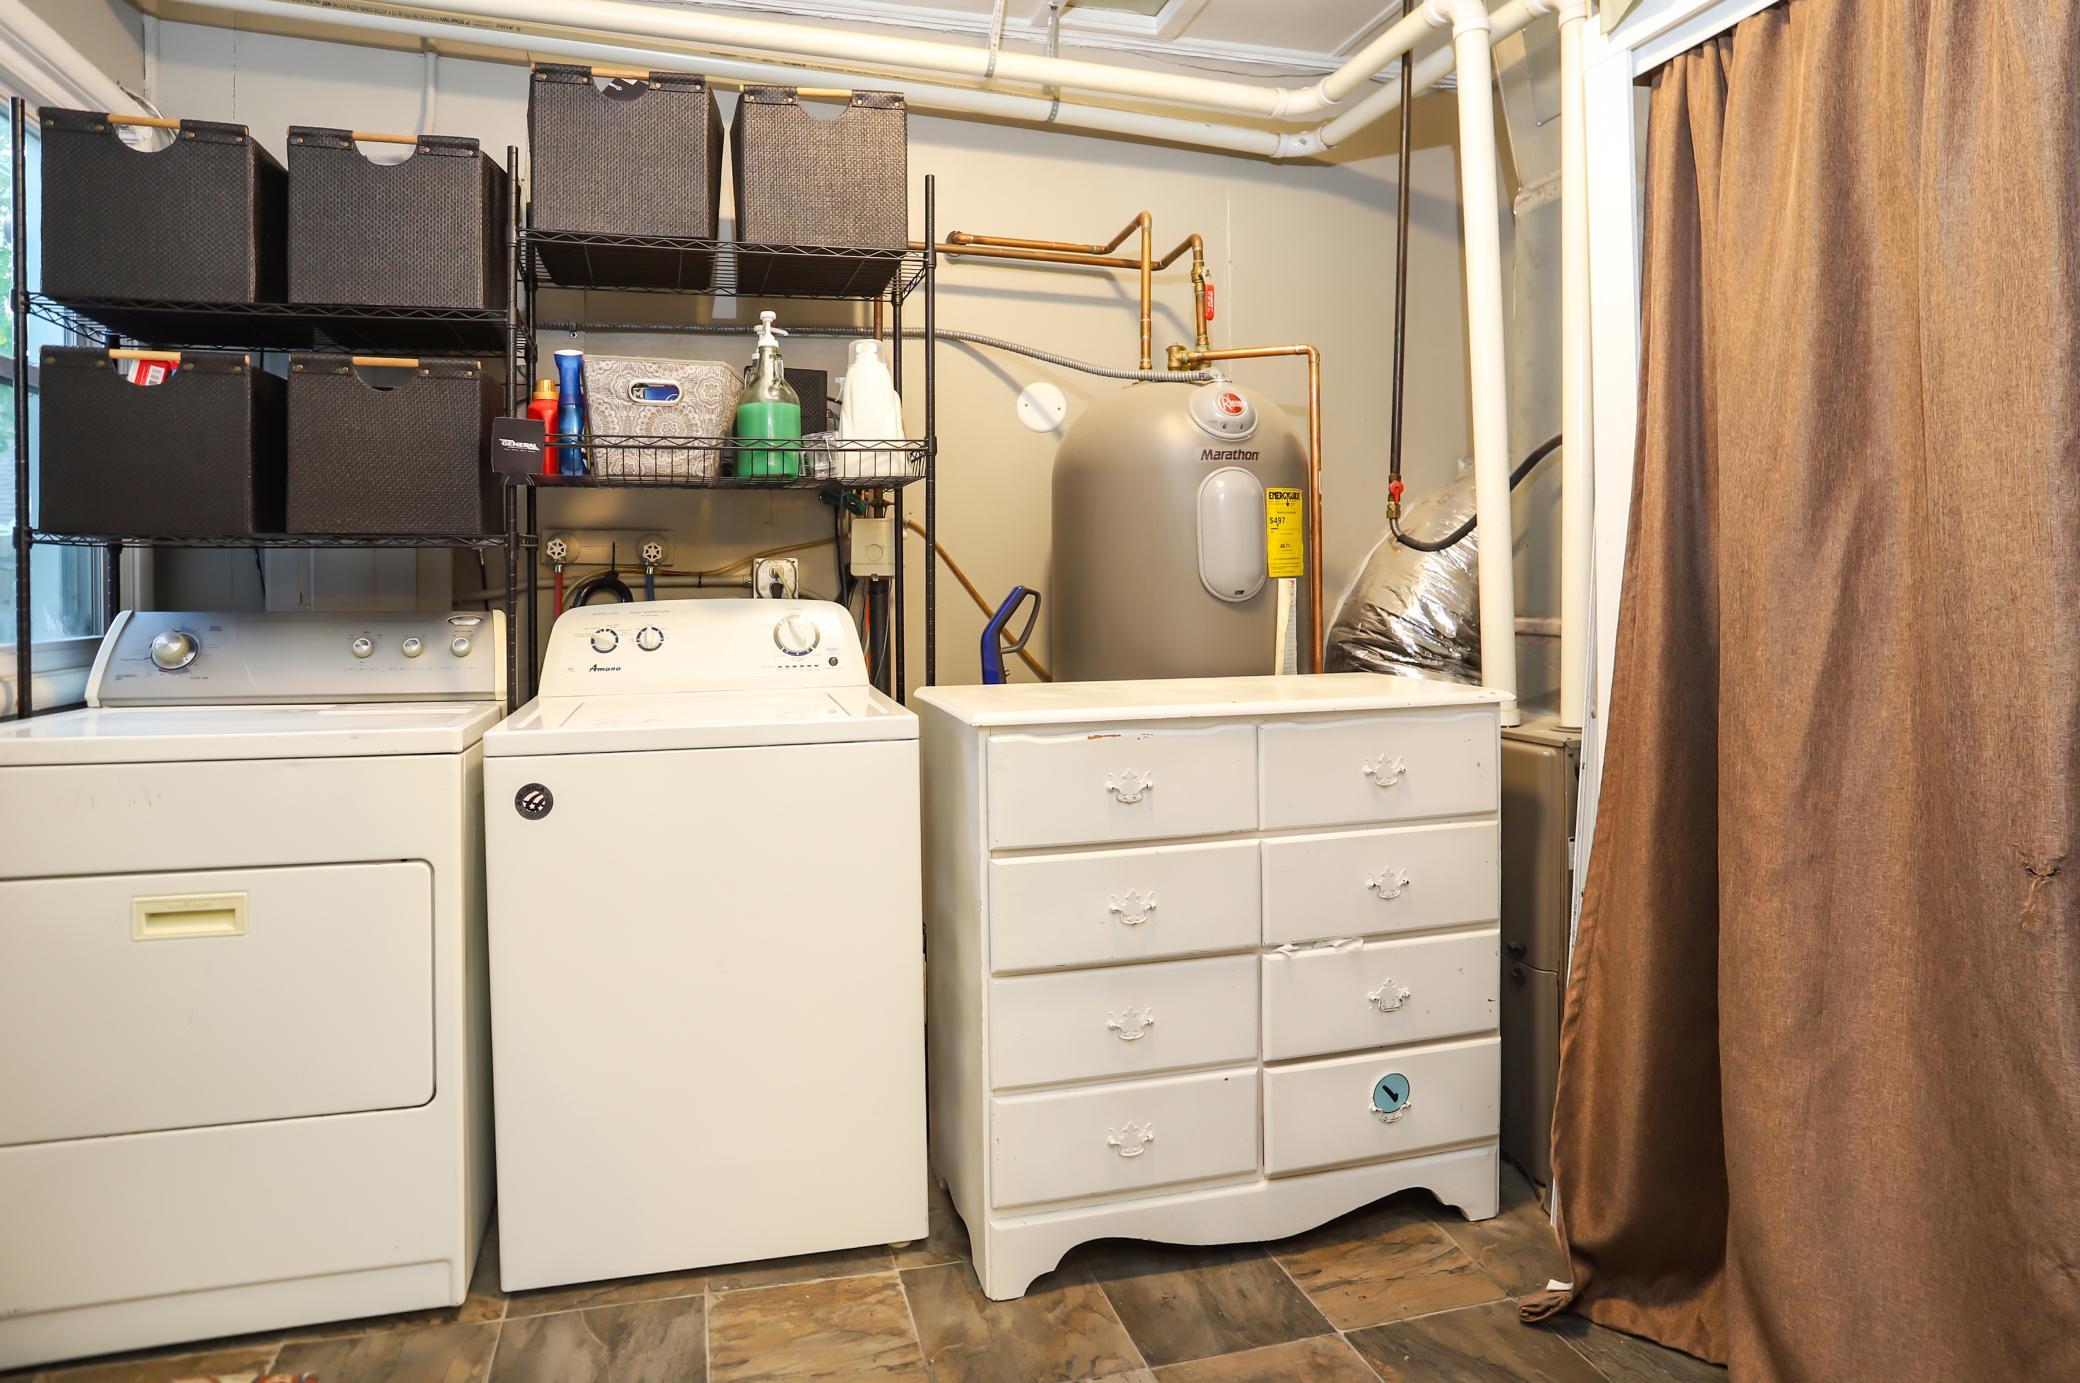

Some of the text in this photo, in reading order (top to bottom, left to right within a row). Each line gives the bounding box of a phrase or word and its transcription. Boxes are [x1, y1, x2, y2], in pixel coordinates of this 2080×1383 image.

[499, 438, 540, 450] GENERAL
[1200, 448, 1260, 461] Marathon
[588, 664, 622, 673] Amana
